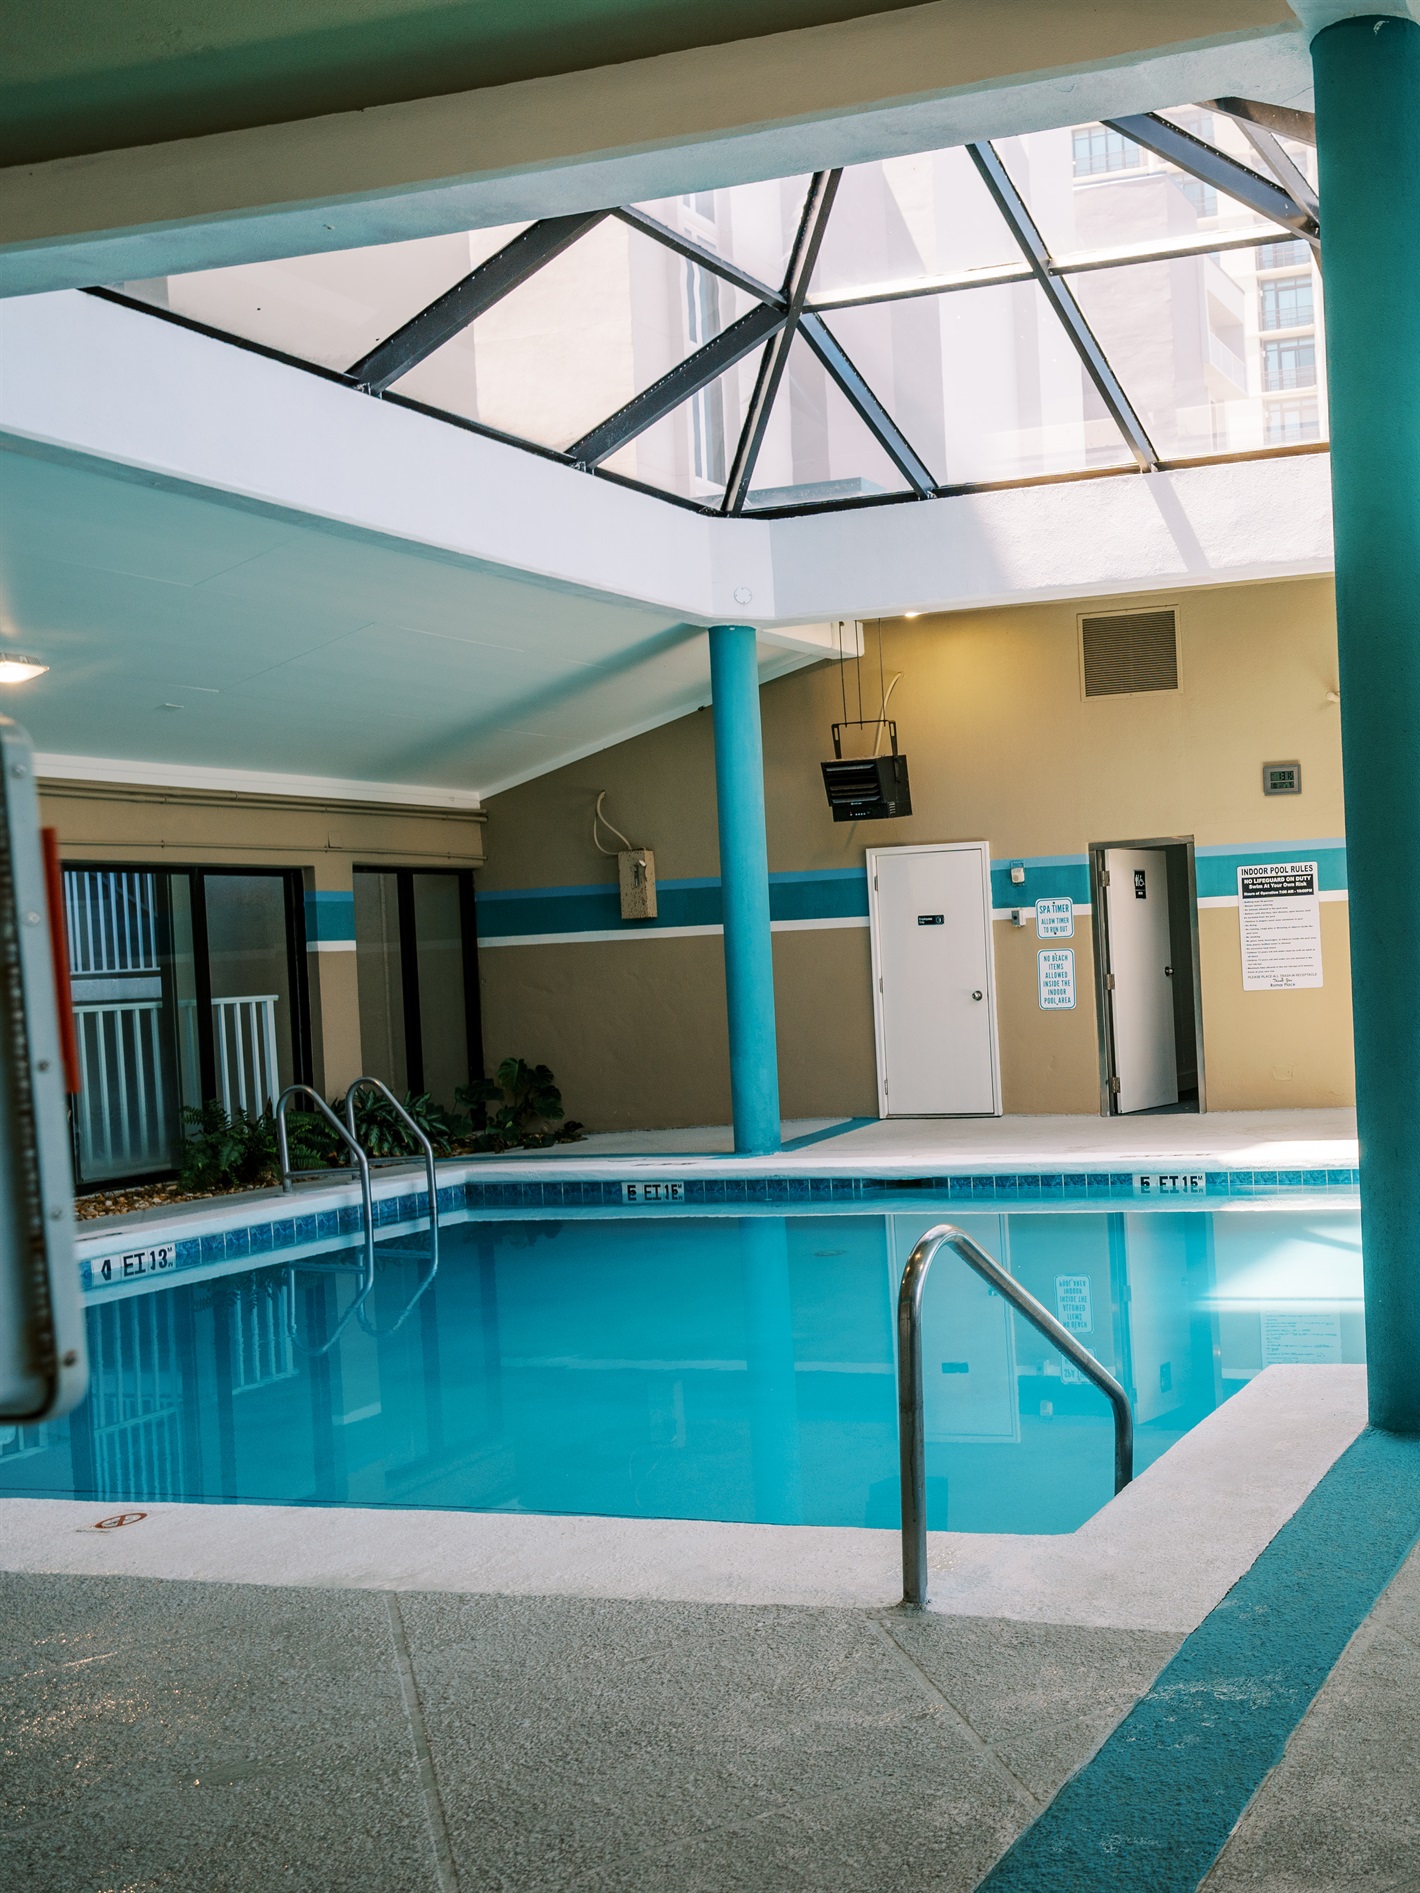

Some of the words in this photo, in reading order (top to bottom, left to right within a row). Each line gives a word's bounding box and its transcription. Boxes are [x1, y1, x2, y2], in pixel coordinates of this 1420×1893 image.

[1242, 868, 1268, 876] INDOOR
[1270, 866, 1288, 874] POOL
[1291, 865, 1313, 873] RULES
[1040, 906, 1050, 914] SPA
[1052, 904, 1069, 914] TIMER
